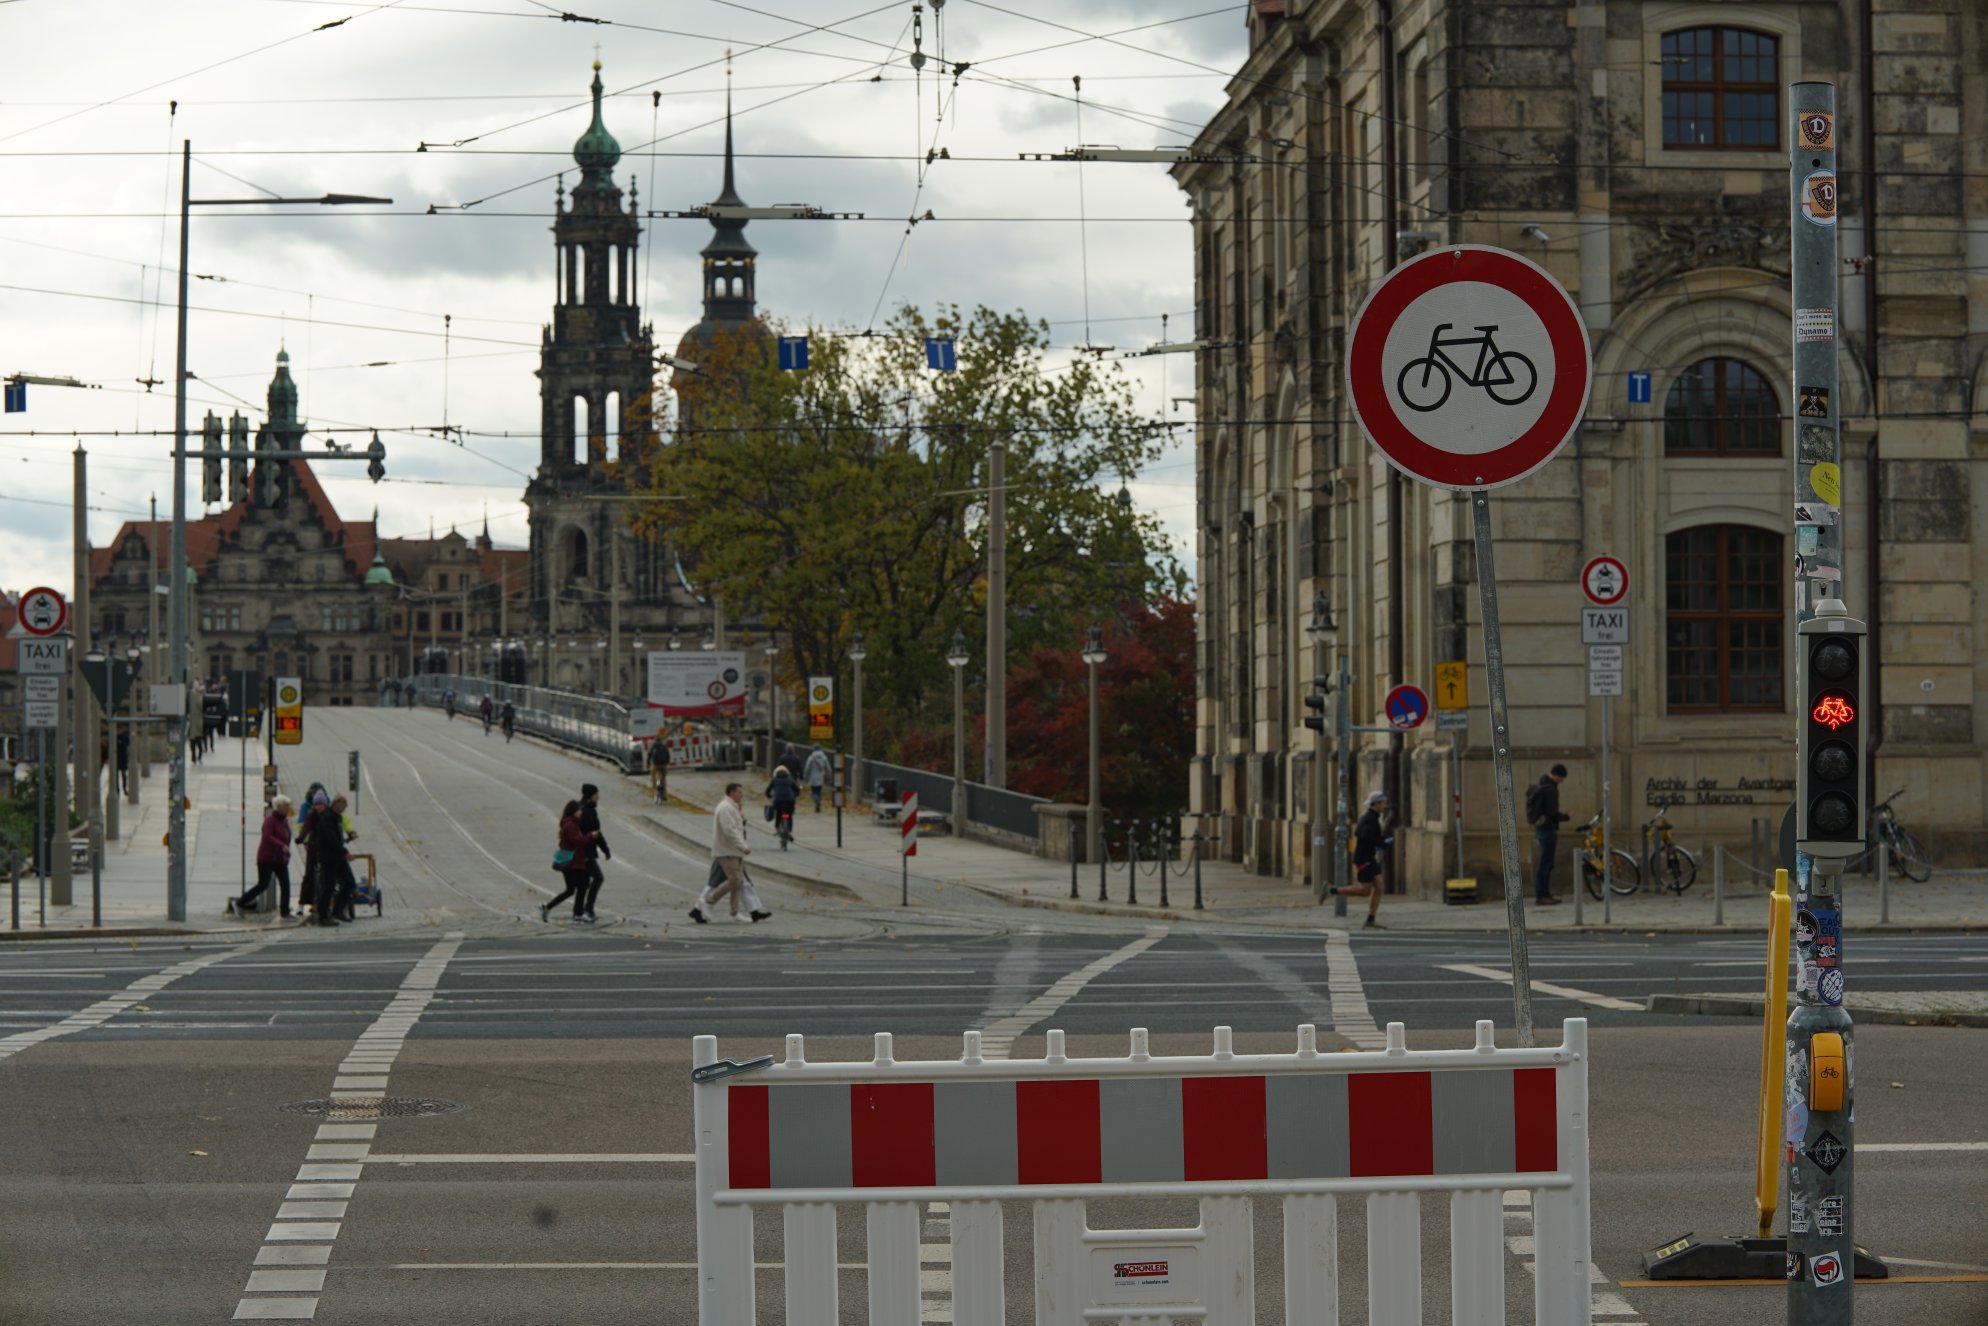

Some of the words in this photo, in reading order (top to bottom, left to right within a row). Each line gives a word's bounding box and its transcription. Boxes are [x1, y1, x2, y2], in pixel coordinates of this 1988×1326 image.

[1798, 328, 1828, 337] Dynamo
[1587, 613, 1623, 629] TAXI
[1598, 631, 1614, 640] frei
[24, 644, 60, 659] TAXI
[34, 662, 51, 671] frei
[1647, 777, 1687, 789] Archiv
[1697, 778, 1718, 789] der
[1647, 793, 1686, 806] Egidio
[1697, 793, 1753, 804] Marzona
[1114, 1261, 1168, 1277] SCHÖNLEIN
